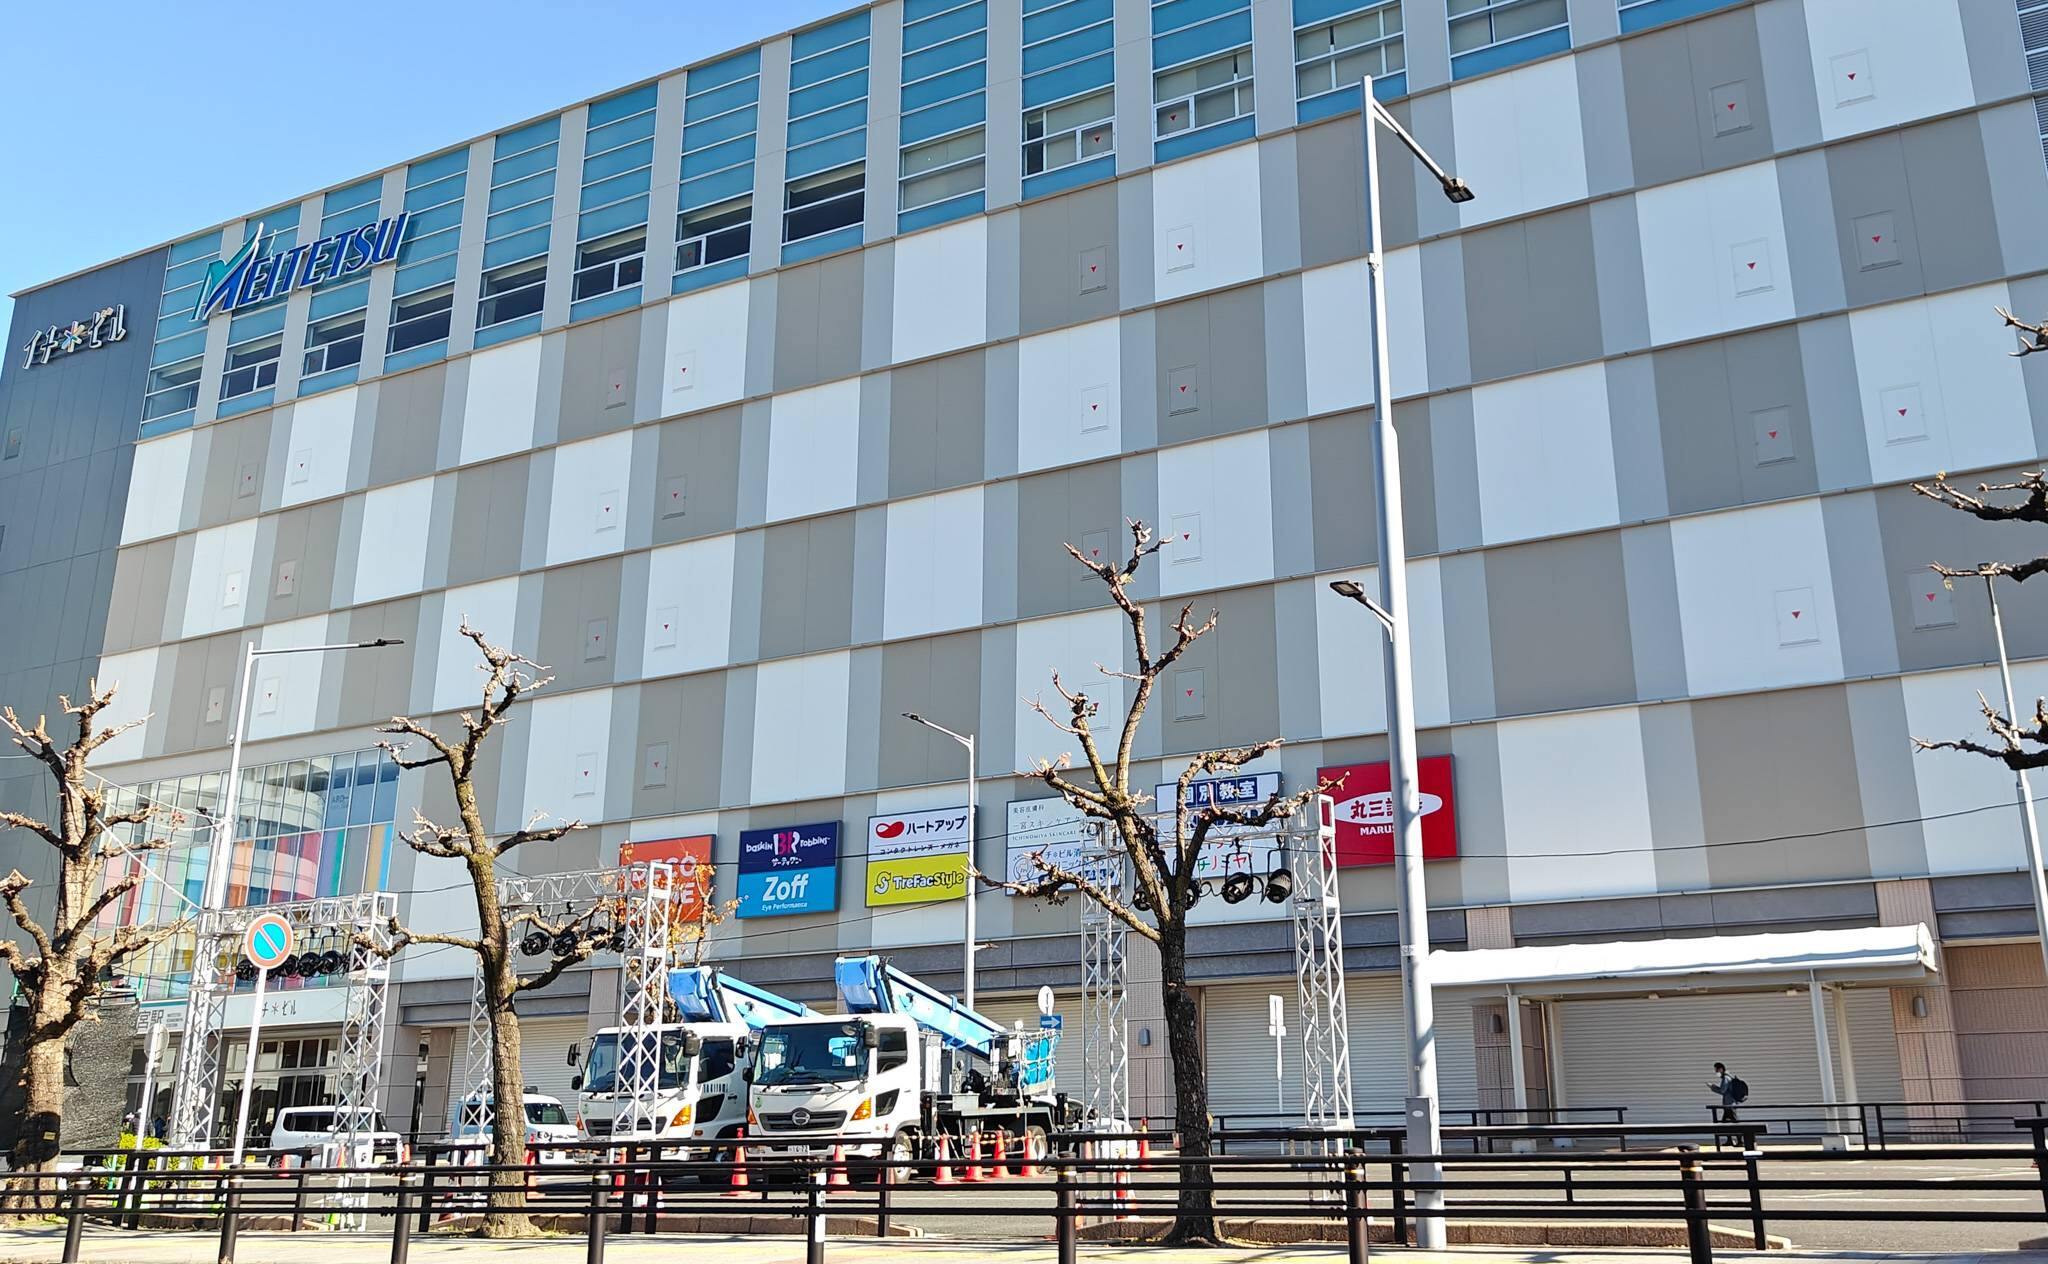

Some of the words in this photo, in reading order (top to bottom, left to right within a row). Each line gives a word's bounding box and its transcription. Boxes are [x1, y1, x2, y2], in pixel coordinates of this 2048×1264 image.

[189, 211, 411, 322] MEITETSU
[906, 816, 968, 835] ハートアップ
[746, 841, 774, 853] baskin
[800, 836, 828, 848] robbins
[762, 873, 810, 902] Zoff
[893, 871, 965, 889] TreFacStyle
[761, 904, 772, 912] Eye
[772, 902, 808, 911] Performance
